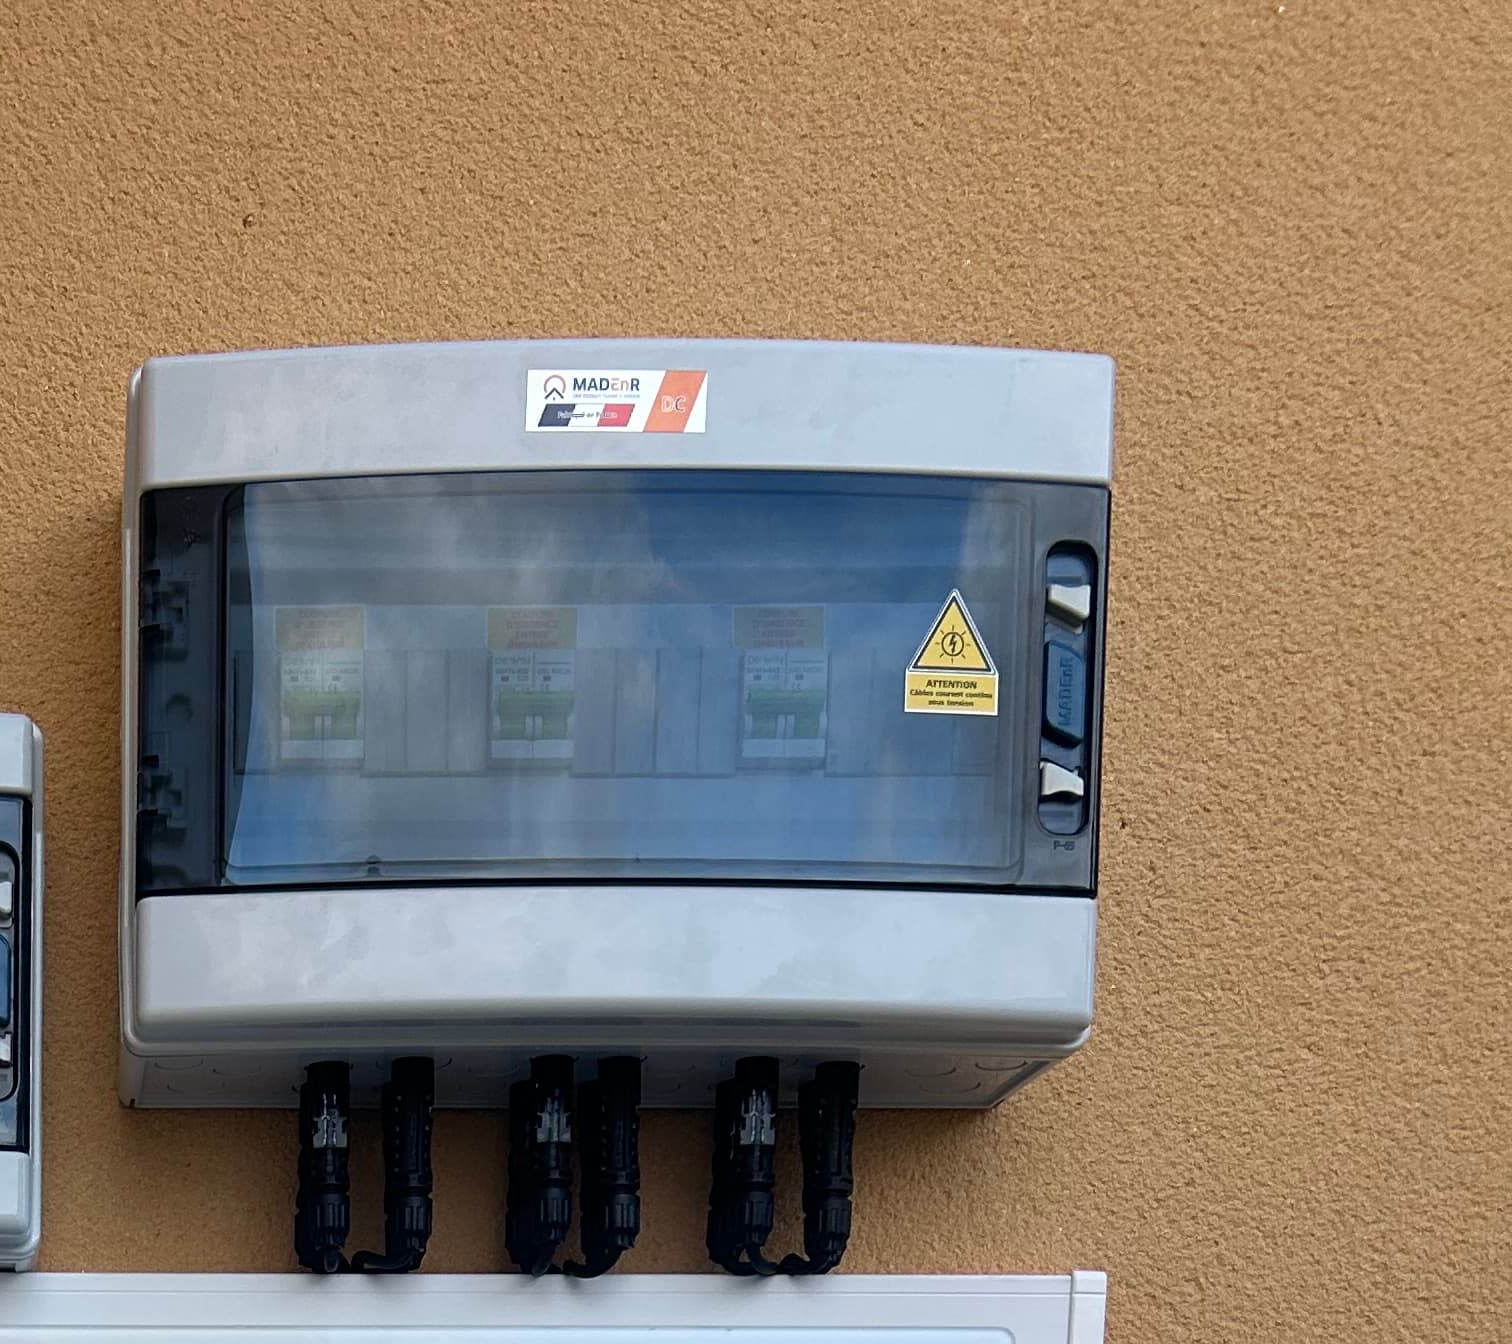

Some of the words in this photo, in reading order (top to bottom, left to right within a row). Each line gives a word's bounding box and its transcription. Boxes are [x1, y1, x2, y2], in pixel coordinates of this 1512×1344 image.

[572, 377, 640, 391] MADEnR
[660, 395, 687, 413] DC
[926, 680, 977, 689] ATTENTION
